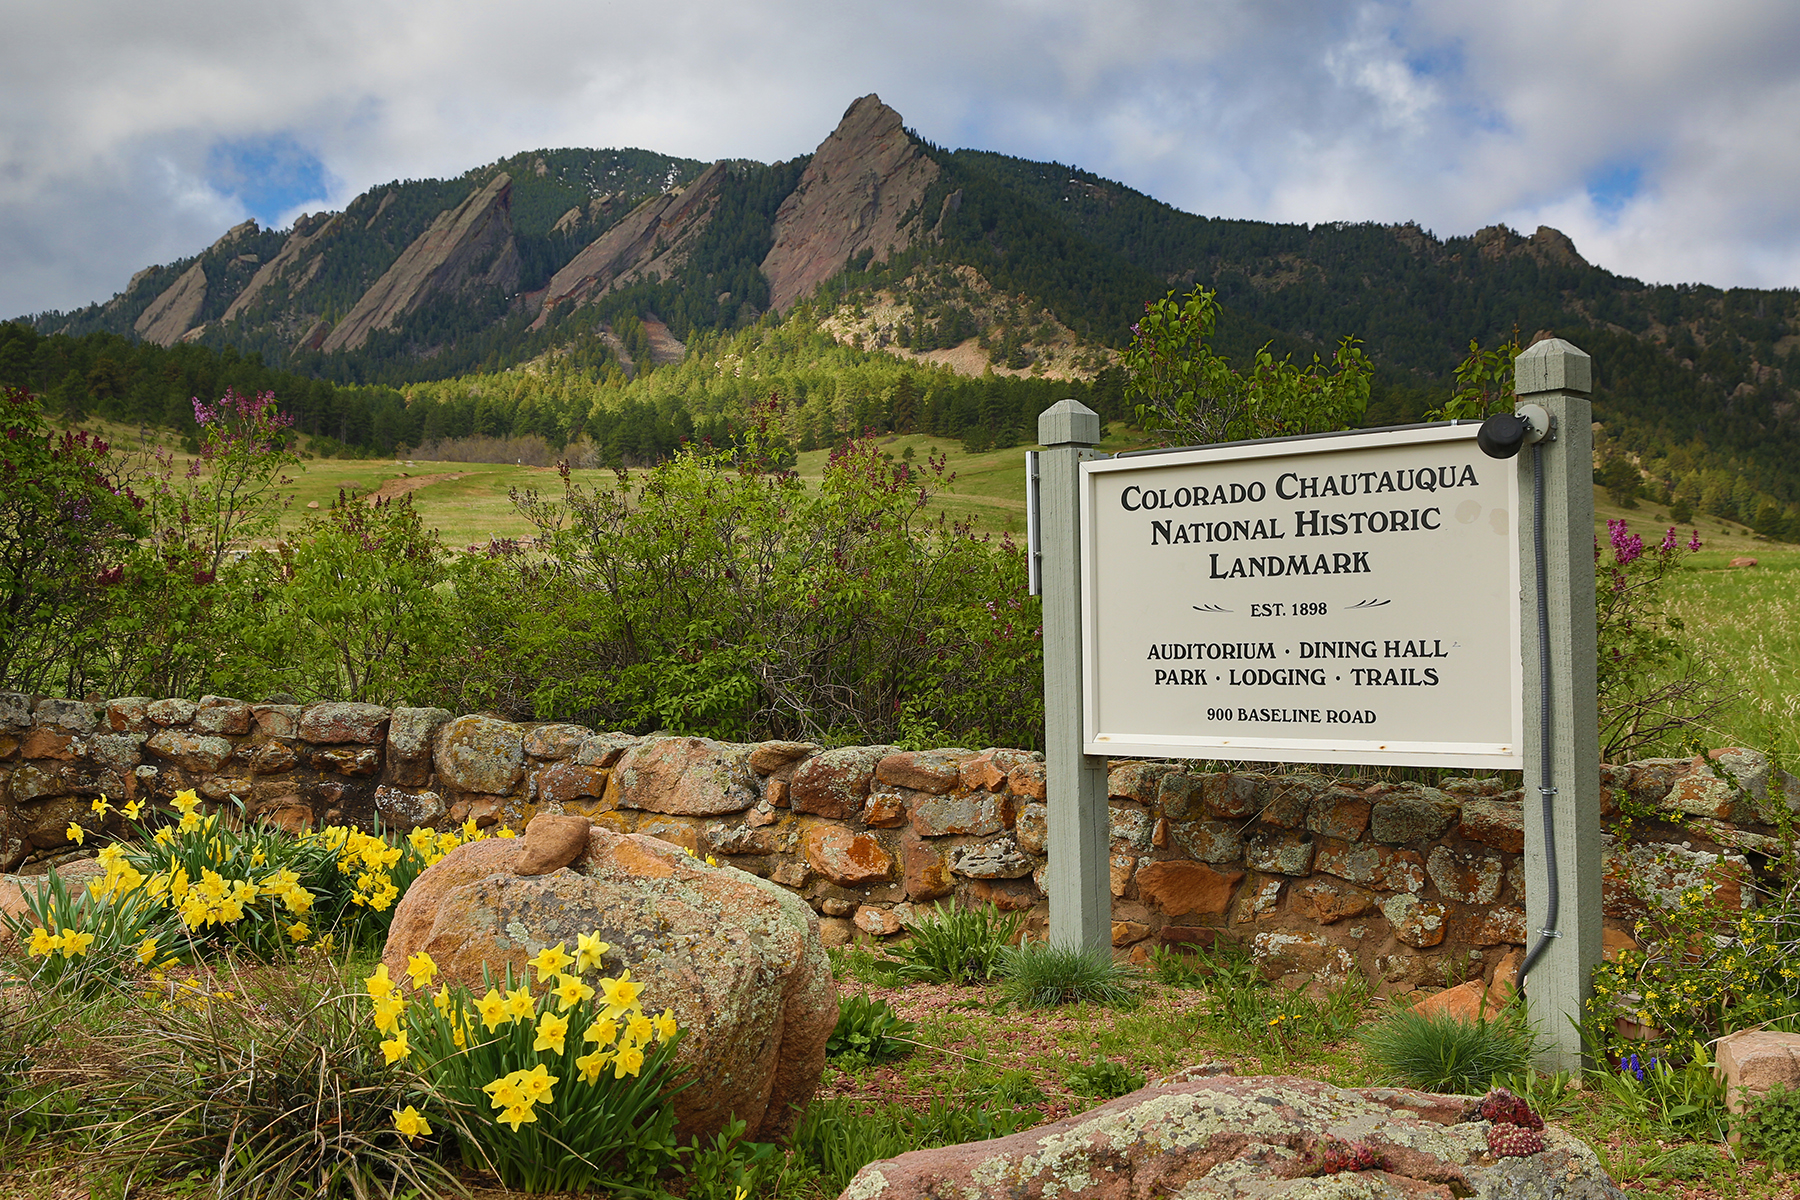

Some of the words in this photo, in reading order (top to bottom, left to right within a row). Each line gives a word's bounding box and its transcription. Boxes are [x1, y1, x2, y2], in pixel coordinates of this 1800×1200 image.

[1120, 481, 1267, 512] COLORADO
[1275, 464, 1480, 501] CHAUTAUQUA
[1150, 518, 1286, 546] NATIONAL
[1294, 506, 1441, 538] HISTORIC
[1208, 551, 1372, 580] LANDMARK
[1250, 603, 1287, 618] EST.
[1291, 601, 1328, 617] 1898
[1146, 642, 1277, 660] AUDITORIUM
[1299, 640, 1378, 659] DINING
[1383, 639, 1449, 658] HALL
[1154, 669, 1208, 686] PARK
[1229, 668, 1327, 687] LODGING
[1349, 667, 1440, 687] TRAILS
[1206, 707, 1234, 722] 900
[1237, 708, 1322, 723] BASELINE
[1325, 709, 1377, 724] ROAD
